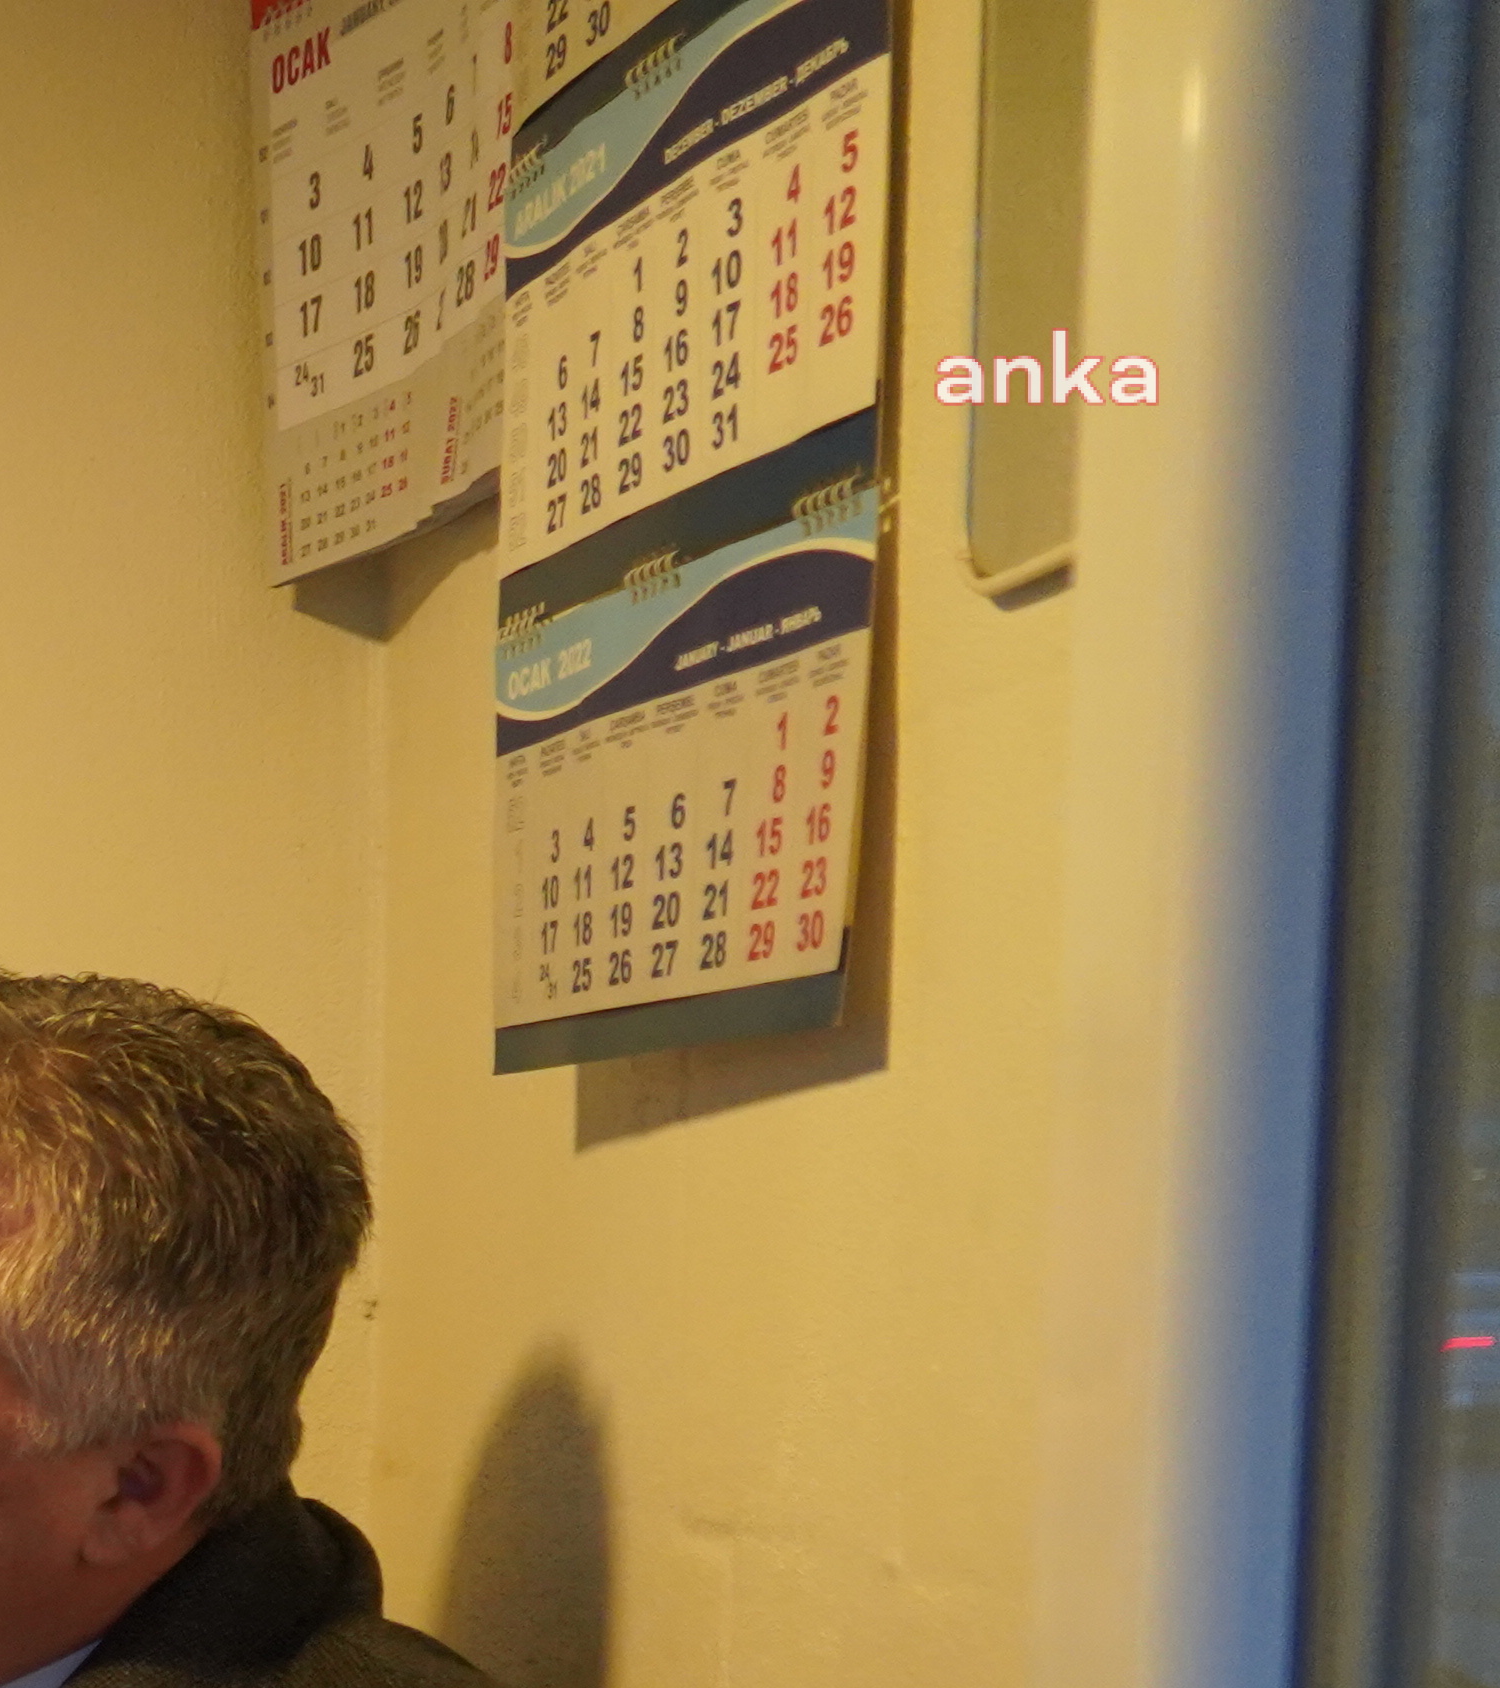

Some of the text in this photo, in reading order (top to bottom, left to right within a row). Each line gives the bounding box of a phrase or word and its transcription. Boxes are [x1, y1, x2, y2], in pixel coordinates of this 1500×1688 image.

[272, 26, 331, 94] OCAK
[504, 21, 513, 64] 8
[545, 6, 610, 80] 29 30
[299, 233, 322, 276] 10
[353, 206, 373, 251] 11
[404, 179, 423, 224] 12
[497, 92, 512, 140] 15
[309, 84, 455, 210] 3 4 5 6
[300, 294, 323, 338] 17
[354, 270, 375, 314] 18
[405, 244, 423, 288] 19
[488, 162, 506, 212] 22
[634, 129, 859, 292] 1 2 3 4 5
[295, 361, 309, 387] 24
[353, 333, 374, 378] 25
[404, 310, 421, 355] 26
[455, 259, 475, 308] 28
[547, 240, 855, 441] 13 14 15 16 17 18 19
[558, 185, 857, 390] 6 7 8 9 10 11 12
[311, 372, 324, 397] 31
[547, 295, 854, 488] 20 21 22 23 24 25 26
[547, 403, 738, 535] 27 28 29 30 31
[507, 638, 593, 700] OCAK 2022
[777, 695, 840, 750] 1 2
[542, 803, 831, 910] 10 11 12 13 14 15 16
[551, 750, 835, 863] 3 4 5 6 7 8 9
[541, 856, 827, 955] 17 18 19 20 21 22 23
[572, 957, 592, 994] 25
[608, 949, 632, 986] 26
[651, 940, 679, 979] 27
[700, 930, 726, 971] 28
[747, 920, 776, 962] 29
[796, 909, 825, 951] 30
